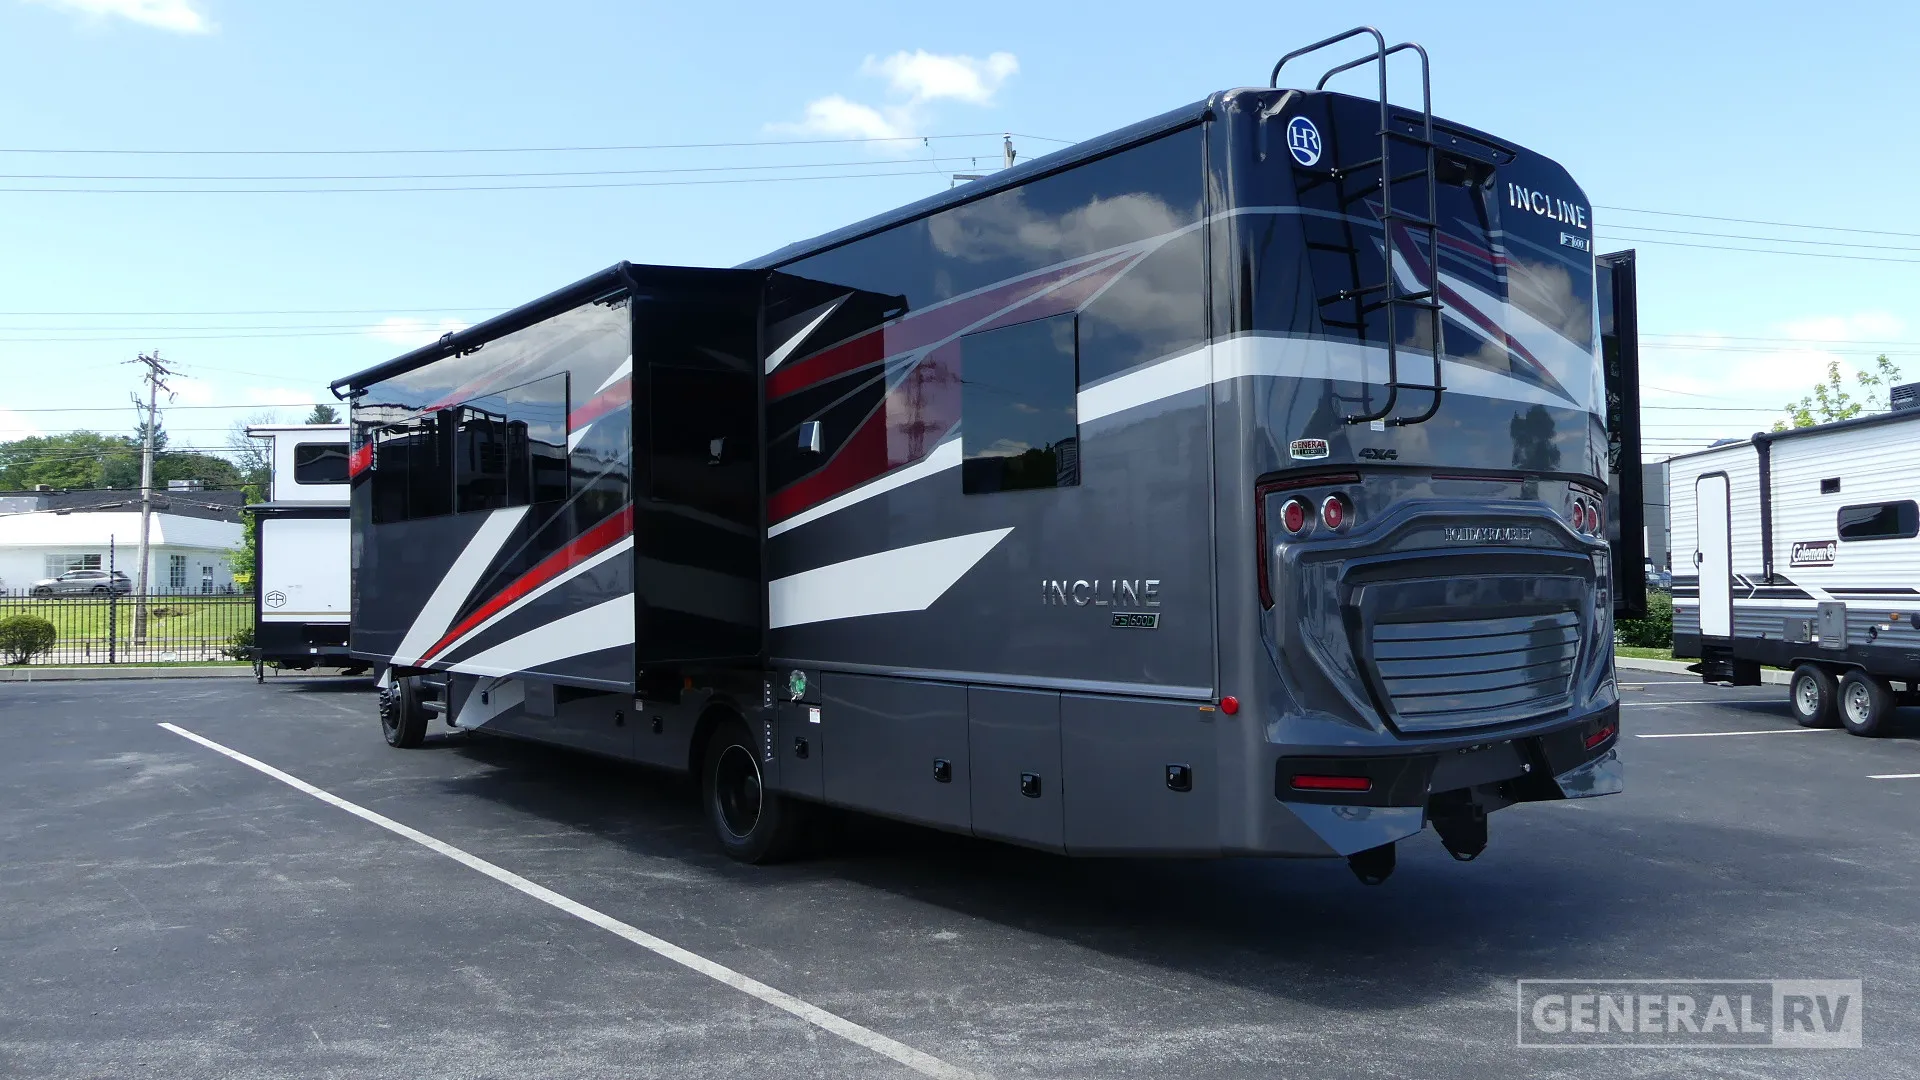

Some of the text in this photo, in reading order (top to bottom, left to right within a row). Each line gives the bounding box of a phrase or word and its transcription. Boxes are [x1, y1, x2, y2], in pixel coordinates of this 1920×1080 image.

[1291, 126, 1319, 150] HR
[1508, 182, 1588, 230] INCLINE
[1291, 440, 1327, 449] GENERAL
[1444, 527, 1487, 541] HOLIDAY
[1792, 543, 1827, 562] Coleman
[1041, 579, 1161, 607] INCLINE
